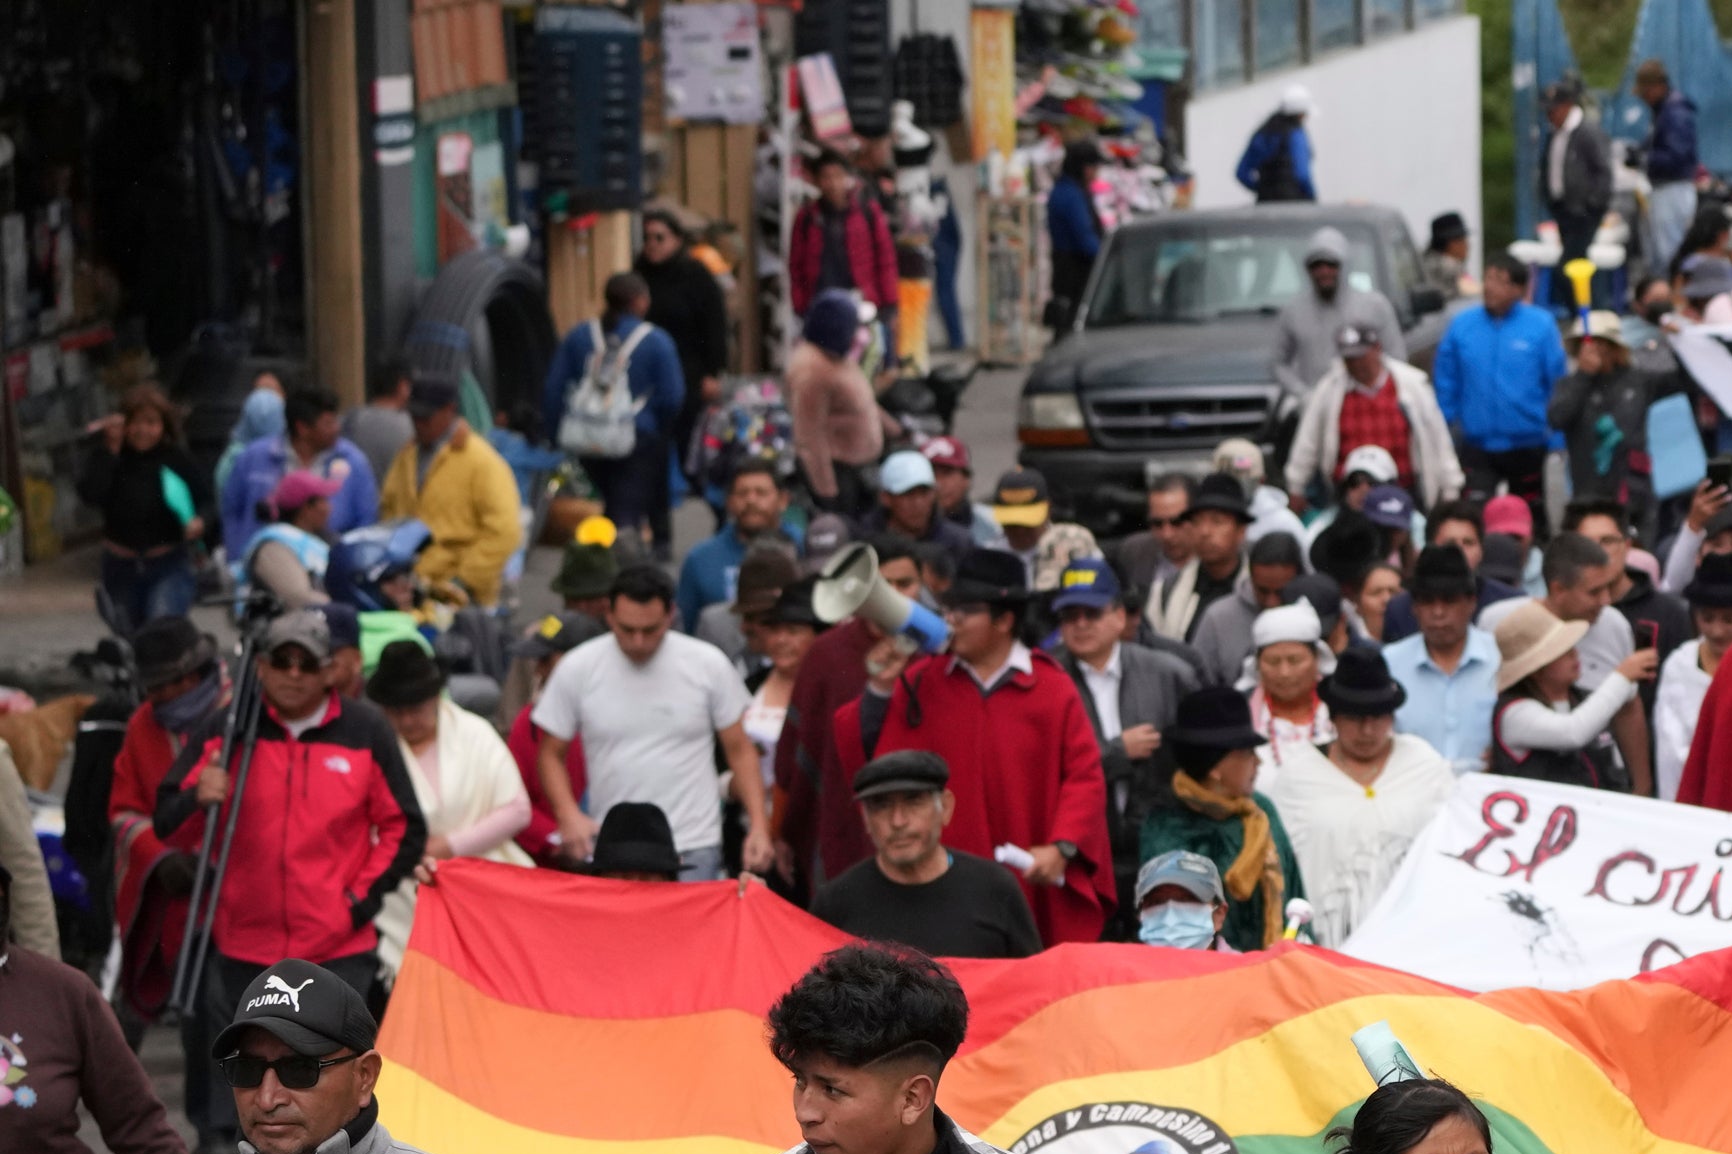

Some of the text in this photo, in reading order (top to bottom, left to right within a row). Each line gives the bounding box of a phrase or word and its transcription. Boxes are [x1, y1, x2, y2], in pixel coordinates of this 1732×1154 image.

[1440, 791, 1578, 883] El
[246, 993, 291, 1012] PUMA
[1065, 1109, 1082, 1131] y
[1089, 1103, 1216, 1147] Campesino
